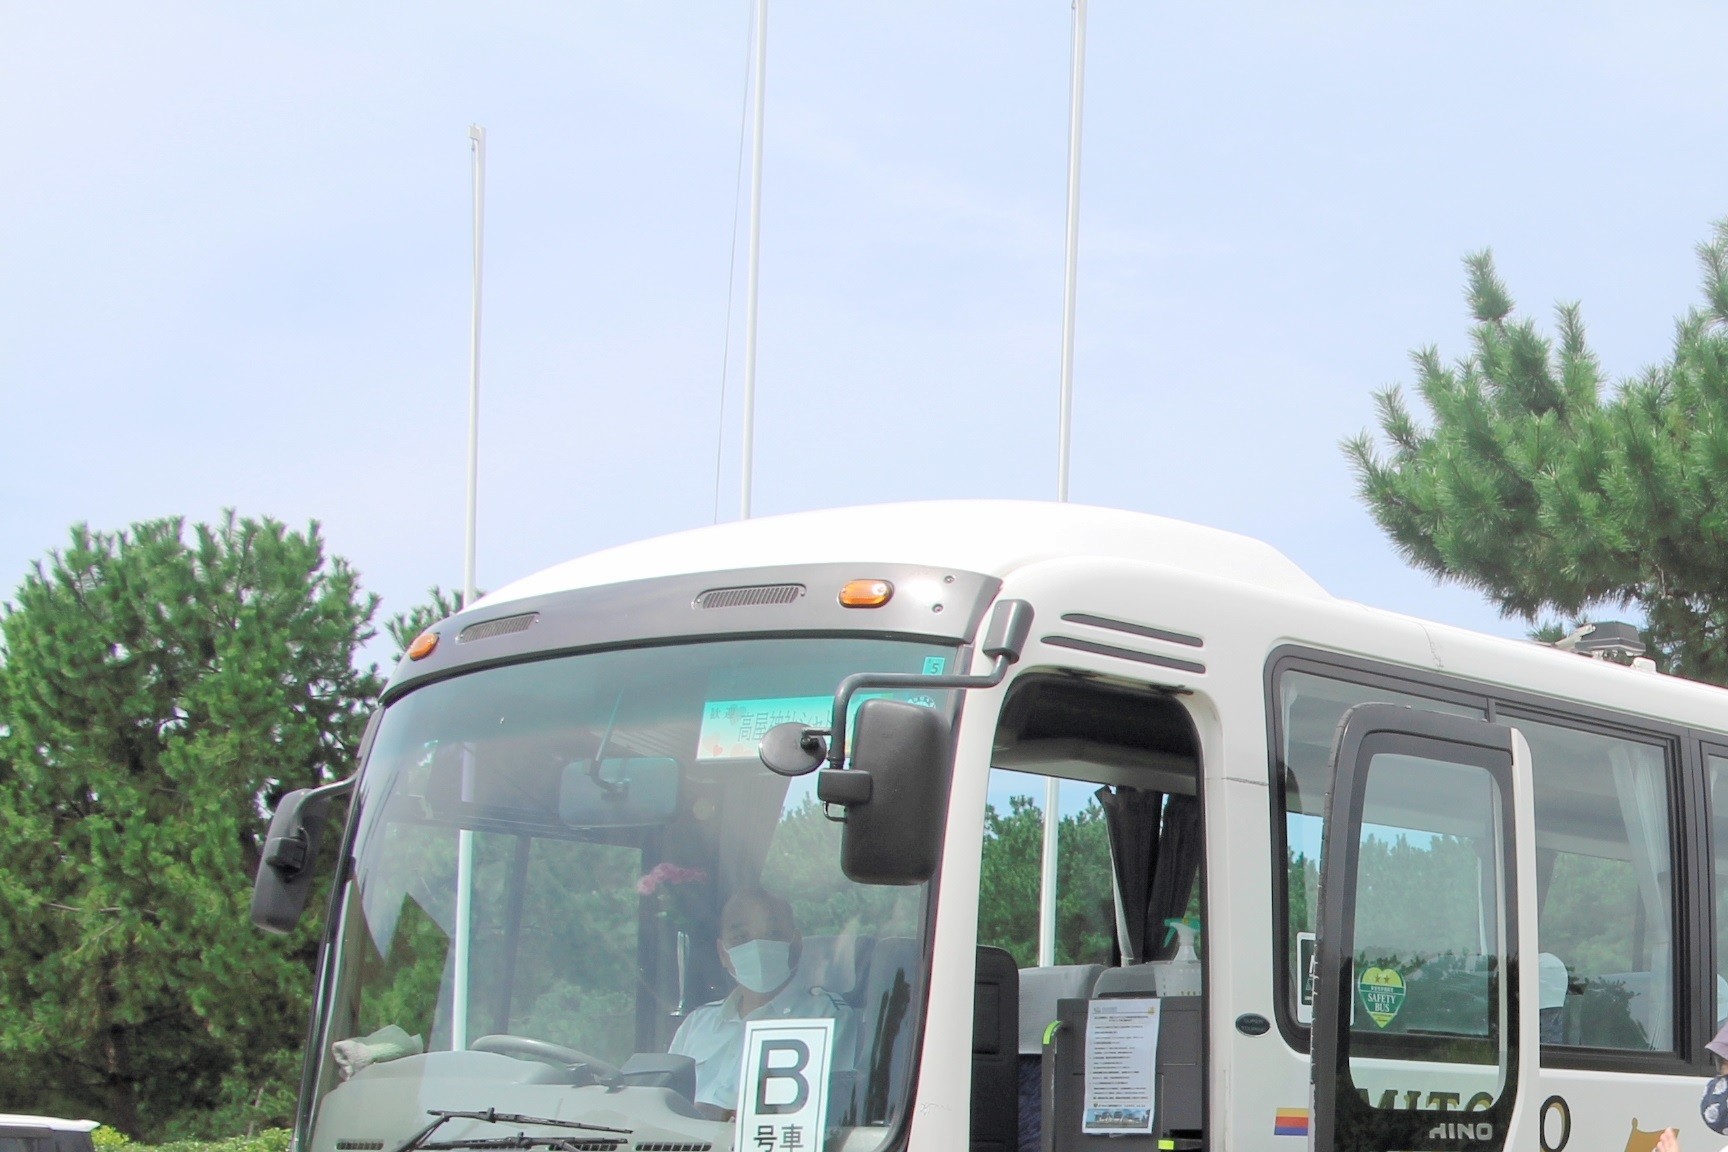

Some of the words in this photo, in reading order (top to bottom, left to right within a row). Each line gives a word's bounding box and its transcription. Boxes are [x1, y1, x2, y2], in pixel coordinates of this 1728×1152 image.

[1367, 993, 1396, 1004] SAFETY
[1375, 1003, 1390, 1012] BUS
[755, 1038, 810, 1116] B
[1429, 1122, 1494, 1141] HINO
